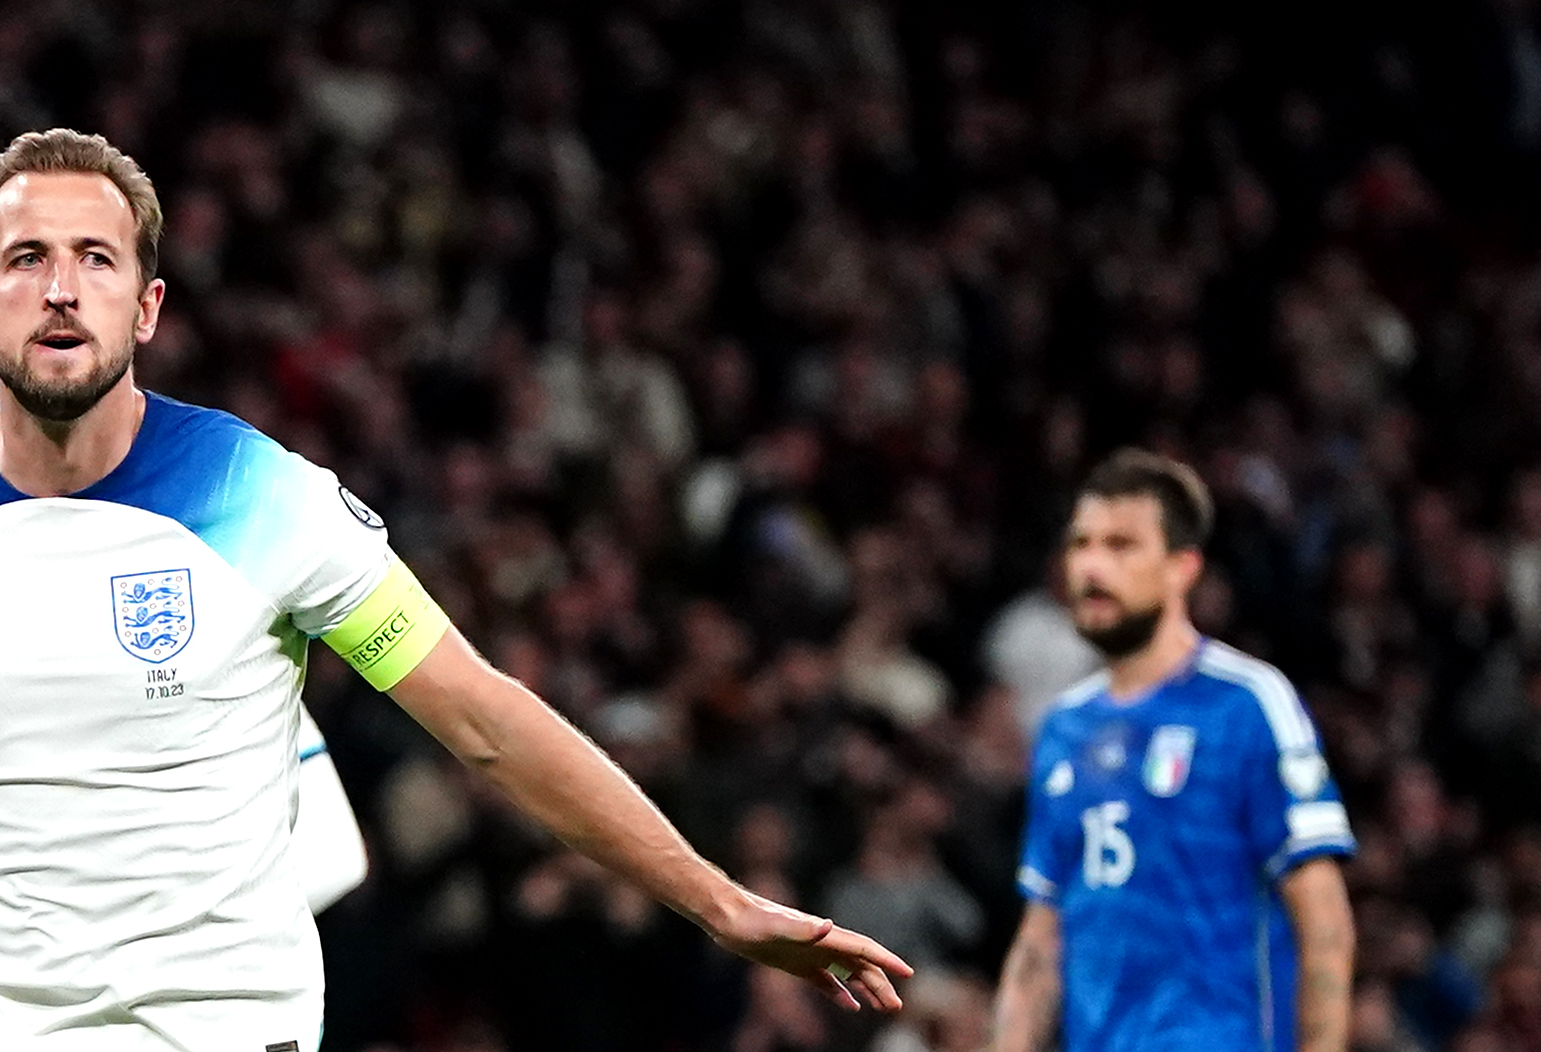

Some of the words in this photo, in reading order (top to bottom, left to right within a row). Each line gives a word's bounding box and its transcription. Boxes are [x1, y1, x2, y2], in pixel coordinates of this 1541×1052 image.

[352, 610, 409, 666] RESPECT
[145, 683, 185, 700] 17.10.23
[146, 668, 177, 683] ITALY
[1082, 800, 1135, 890] 15
